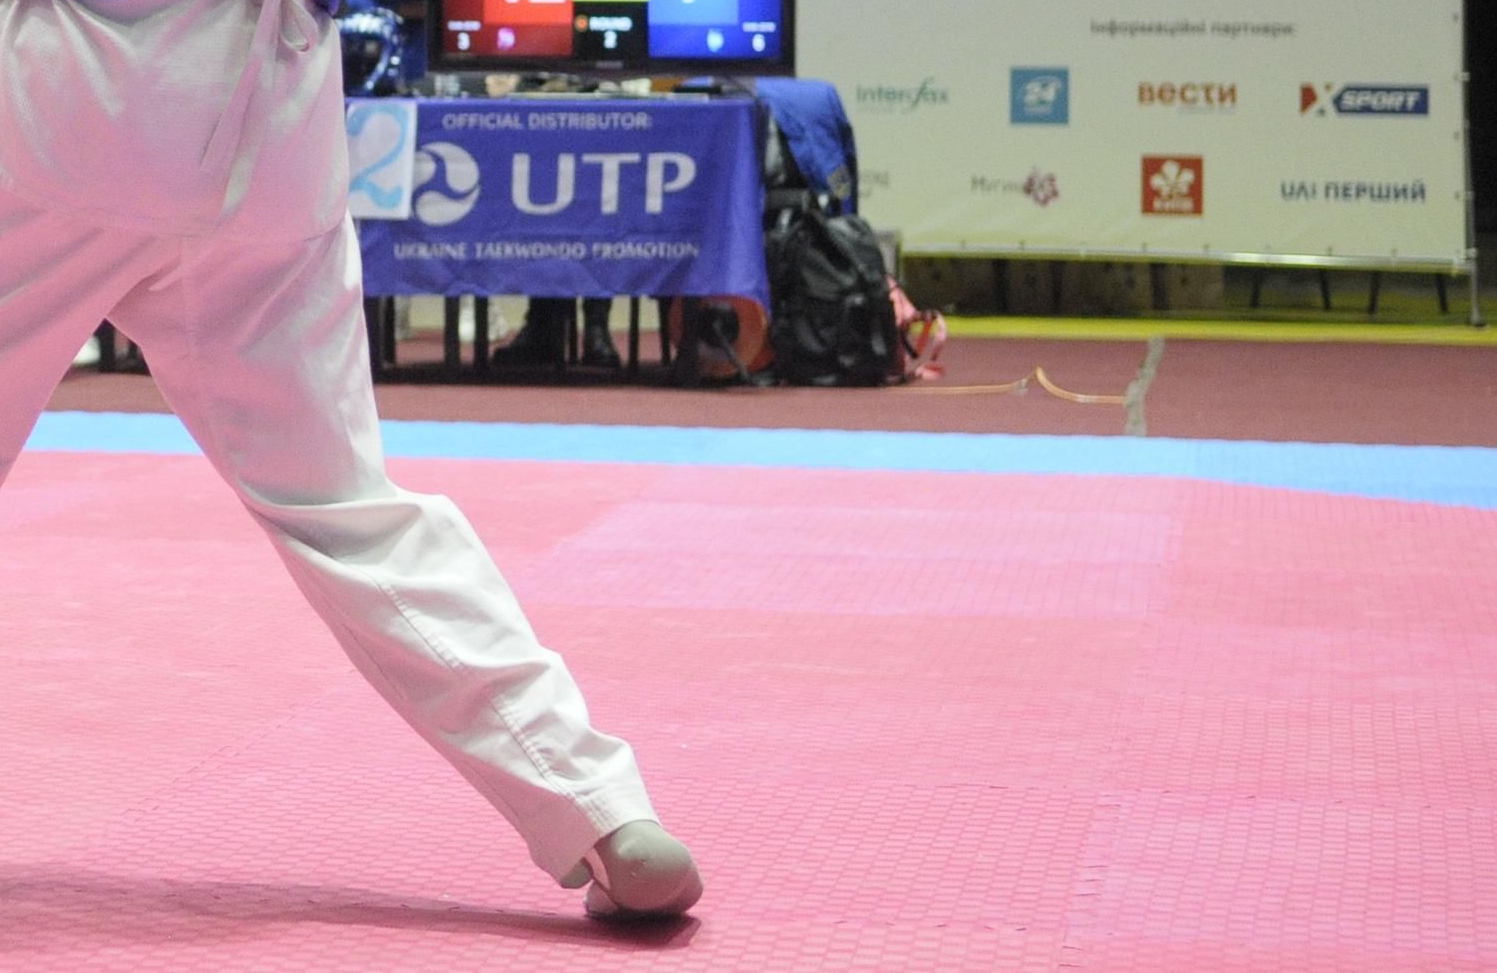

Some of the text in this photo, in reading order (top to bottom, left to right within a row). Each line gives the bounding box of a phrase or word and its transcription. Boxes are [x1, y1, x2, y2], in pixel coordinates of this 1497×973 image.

[442, 111, 523, 132] OFFICIAL
[347, 104, 409, 210] 2
[511, 151, 697, 216] UTP
[1324, 179, 1426, 203] ПЕРШИЙ
[393, 241, 700, 260] UKRAINE TAEKWONDO PROMOTION
